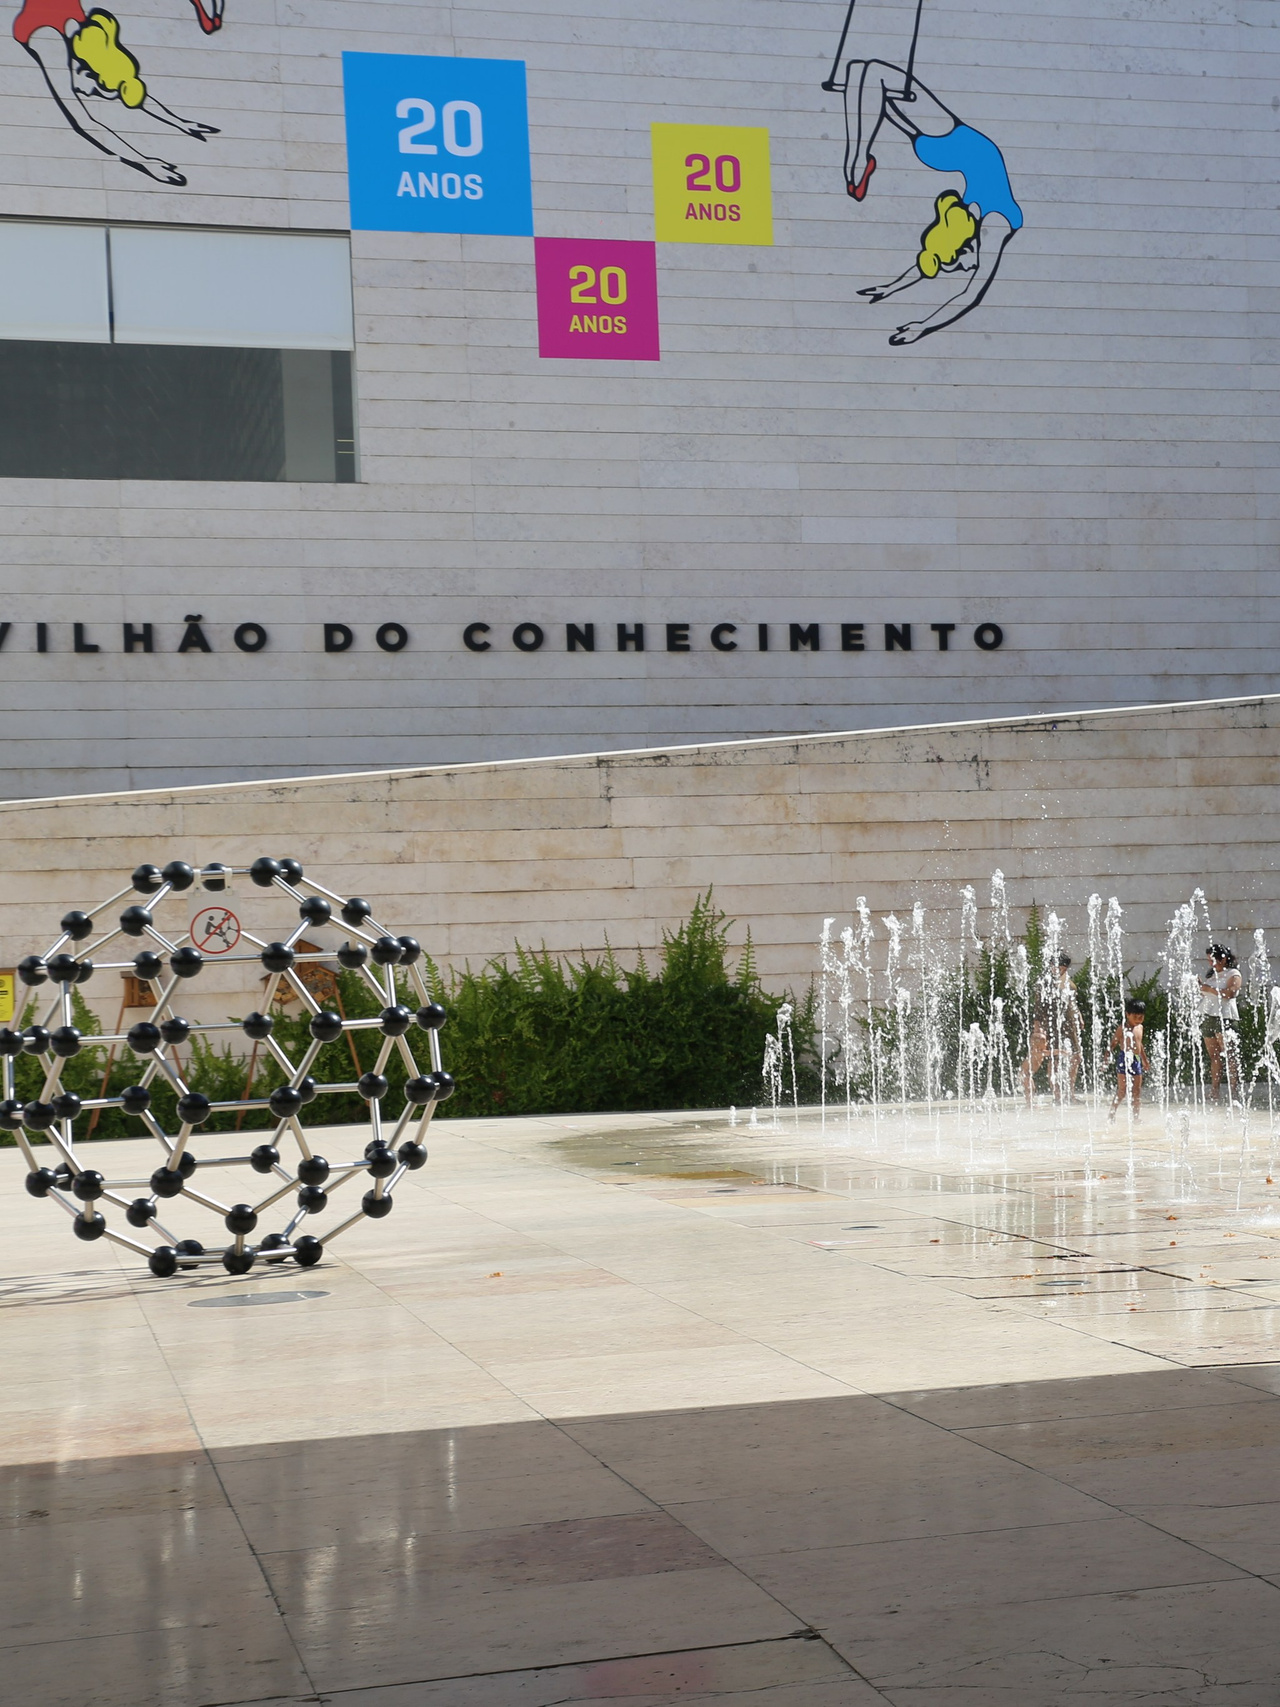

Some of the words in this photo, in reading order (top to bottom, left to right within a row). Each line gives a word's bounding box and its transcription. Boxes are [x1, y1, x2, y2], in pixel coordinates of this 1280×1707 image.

[396, 97, 483, 157] 20
[397, 171, 484, 200] ANOS
[684, 153, 741, 193] 20
[685, 202, 741, 222] ANOS
[568, 264, 628, 305] 20
[569, 314, 627, 335] ANOS
[323, 622, 409, 653] DO
[462, 622, 1005, 653] CONHECIMENTO
